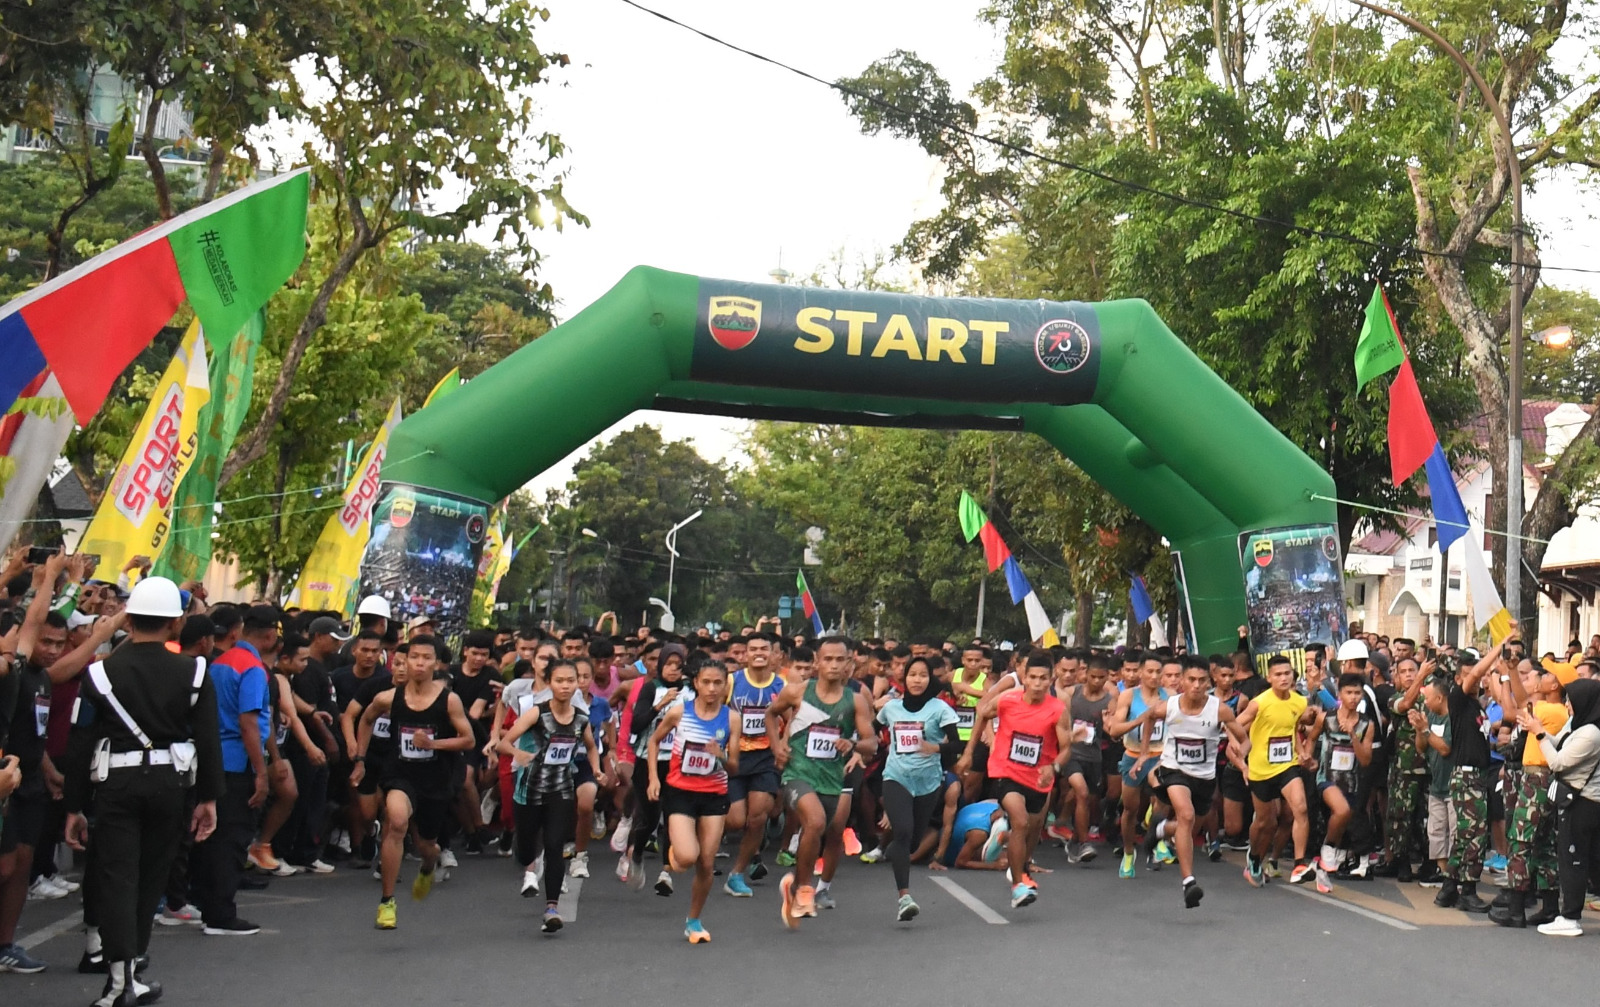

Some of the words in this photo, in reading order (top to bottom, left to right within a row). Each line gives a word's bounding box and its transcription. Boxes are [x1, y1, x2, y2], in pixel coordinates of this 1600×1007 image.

[793, 306, 1010, 366] START
[122, 393, 183, 519] SPORT
[342, 449, 385, 530] SPORT
[429, 504, 462, 519] START
[151, 521, 168, 549] GO
[1284, 537, 1314, 548] START
[812, 738, 836, 752] 1237
[900, 735, 919, 746] 866
[1014, 743, 1036, 758] 1405
[1180, 748, 1202, 758] 1403
[688, 755, 710, 769] 994
